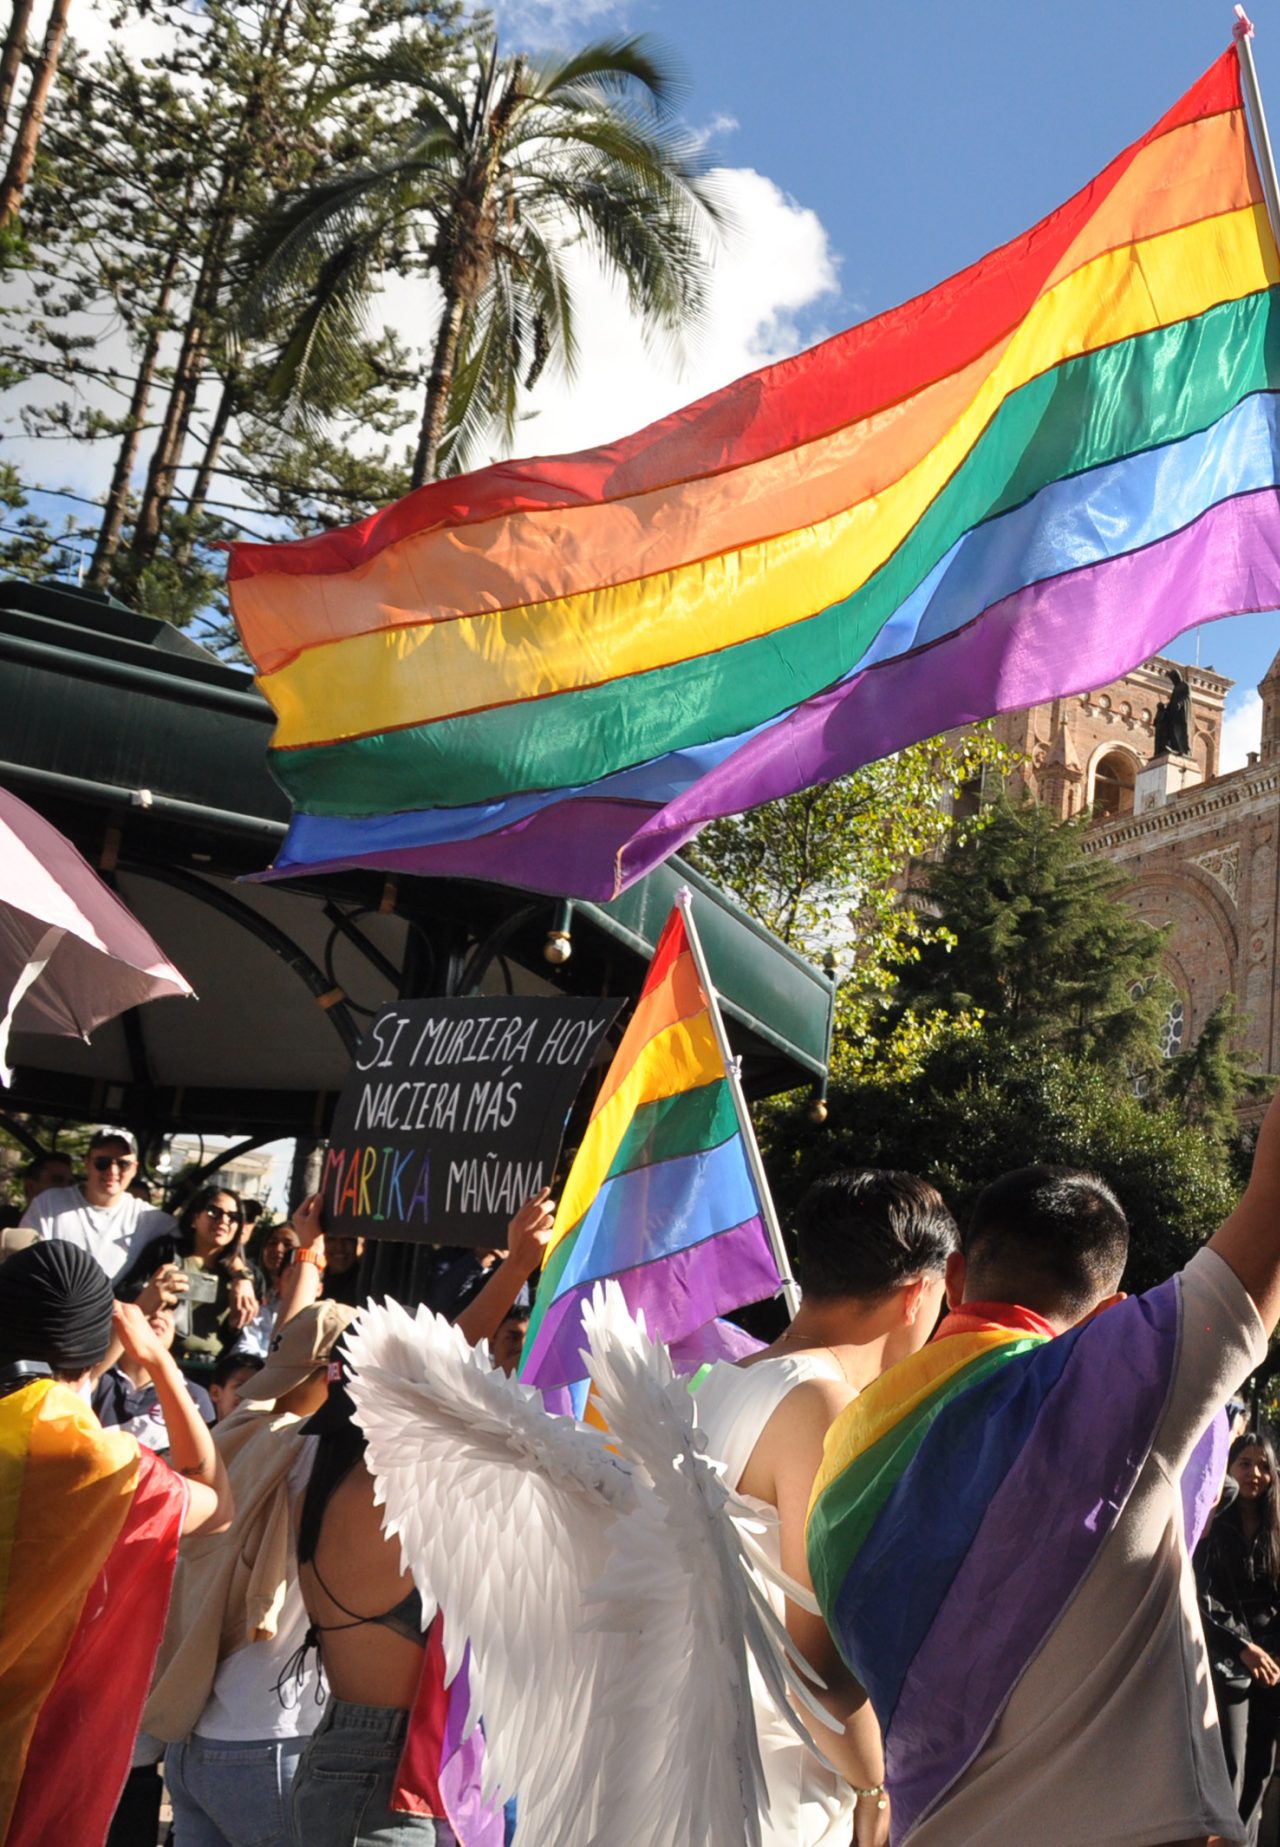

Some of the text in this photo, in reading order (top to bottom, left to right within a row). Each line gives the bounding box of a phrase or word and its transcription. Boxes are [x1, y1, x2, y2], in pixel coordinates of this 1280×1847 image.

[356, 1012, 605, 1071] SI MURIERA HOY
[354, 1065, 522, 1132] NACIERA MÁS
[322, 1147, 543, 1223] MARIKA MAÑANA
